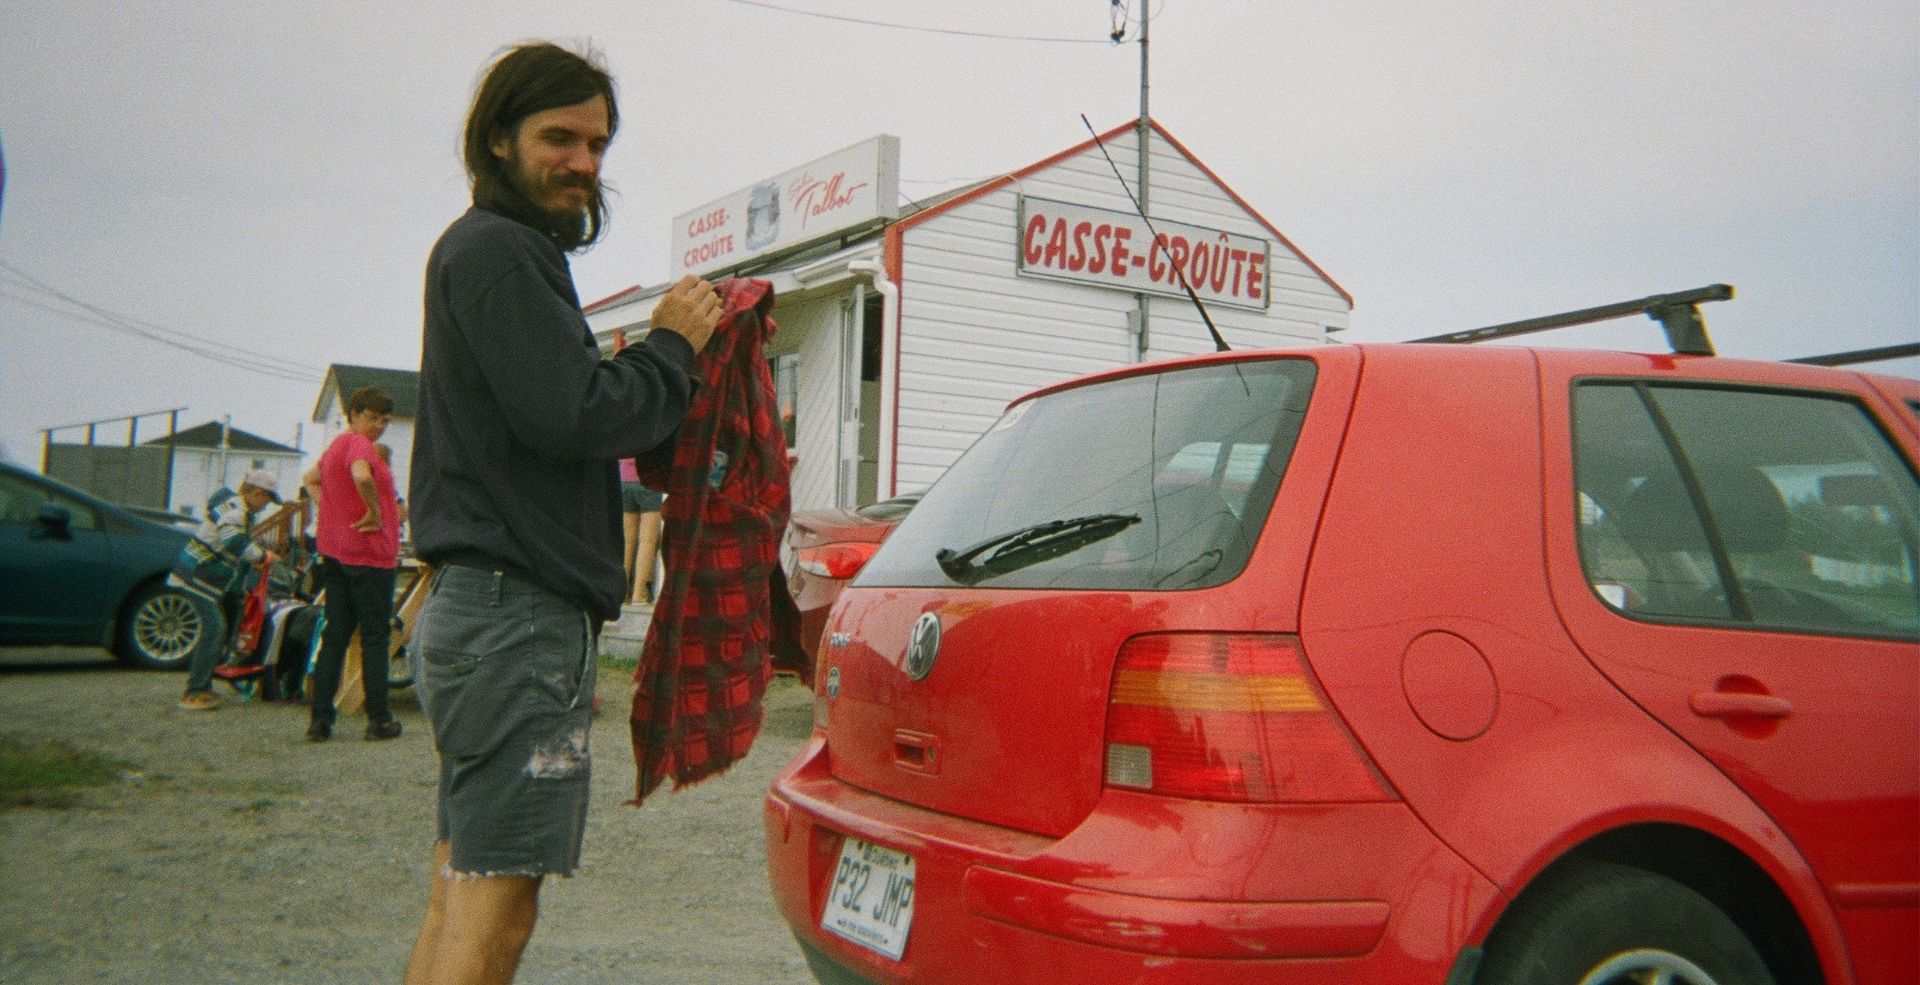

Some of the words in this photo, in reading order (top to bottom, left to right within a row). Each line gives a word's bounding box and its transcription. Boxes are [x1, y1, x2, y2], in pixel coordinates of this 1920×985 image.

[688, 208, 730, 238] CASSE-
[795, 172, 867, 230] Talbot
[1024, 213, 1265, 299] CASSE-CROÛTE
[831, 856, 870, 912] P32
[873, 873, 914, 928] JMP
